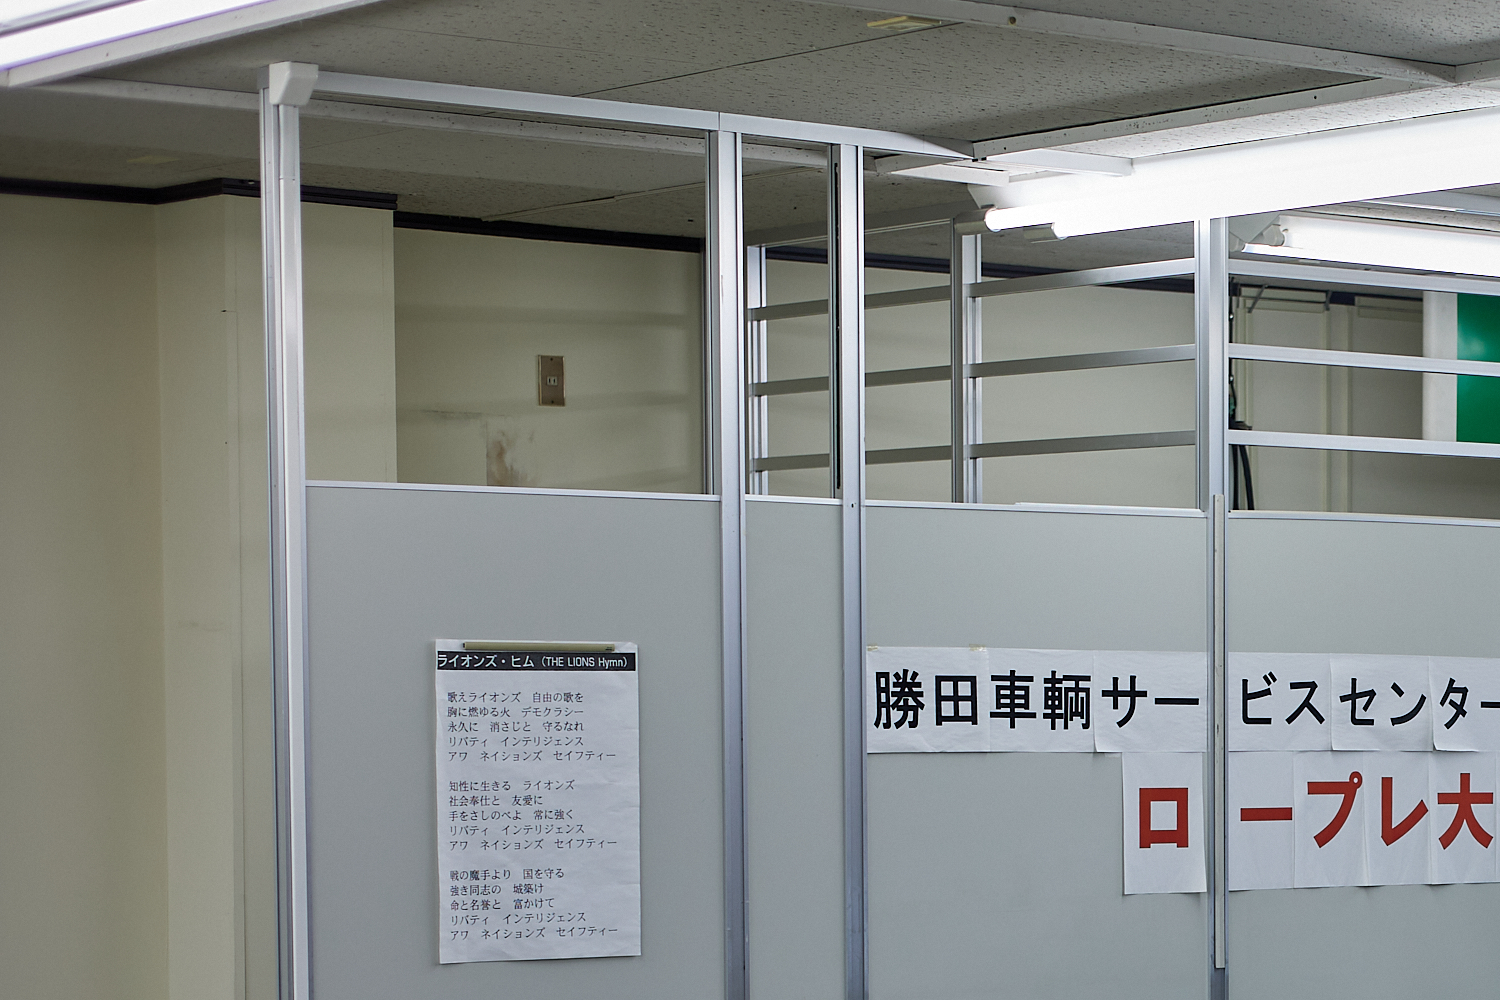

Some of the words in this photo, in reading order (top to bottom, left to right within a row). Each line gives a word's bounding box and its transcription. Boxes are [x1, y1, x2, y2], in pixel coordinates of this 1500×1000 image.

[568, 657, 594, 667] LIONS
[448, 692, 521, 703] 歌えライオンズ
[532, 692, 583, 703] 自由の歌を
[447, 707, 510, 717] 胸に燃ゆる火
[521, 707, 583, 717] デモクラシー
[448, 721, 478, 732] 永久に
[490, 721, 531, 732] 消さじと
[543, 721, 583, 732] 守るなれ
[501, 736, 583, 747] インテリジェンス
[448, 752, 467, 761] アワ
[480, 751, 542, 761] ネイションズ
[553, 751, 616, 760] セイフティー
[449, 781, 511, 791] 知性に生きる
[523, 780, 575, 790] ライオンズ
[449, 796, 500, 806] 社会奉仕と
[512, 795, 543, 806] 友愛に
[534, 810, 573, 820] 常に強く
[501, 824, 584, 836] インテリジェンス
[449, 841, 468, 851] アワ
[480, 839, 543, 850] ネイションズ
[555, 838, 617, 849] セイフティー
[523, 869, 564, 879] 国を守る
[450, 885, 501, 896] 強き同志の
[513, 883, 543, 894] 城築け
[450, 899, 501, 911] 命と名誉と
[503, 912, 586, 924] インテリジェンス
[451, 931, 468, 940] アワ
[481, 928, 545, 940] ネイションズ
[556, 927, 618, 937] セイフティー
